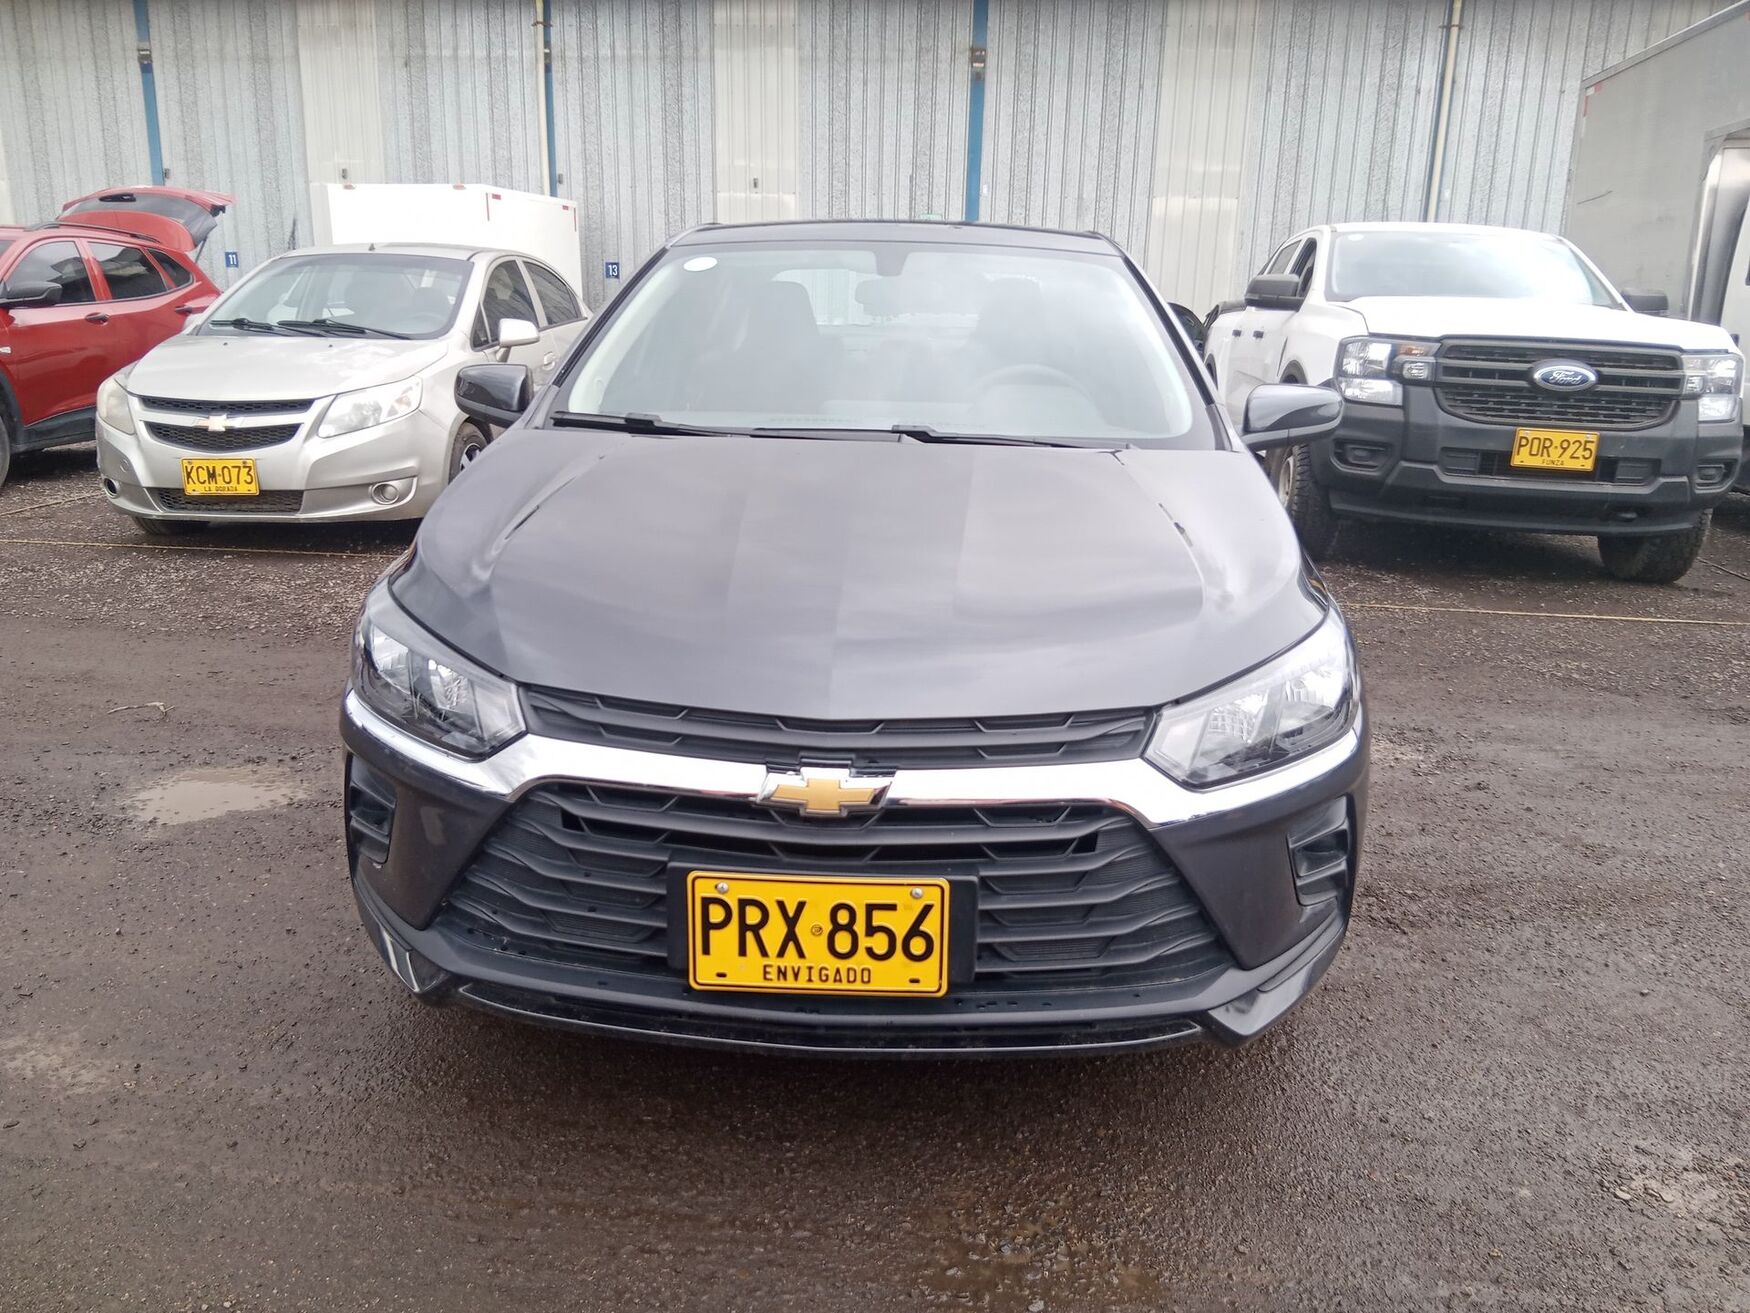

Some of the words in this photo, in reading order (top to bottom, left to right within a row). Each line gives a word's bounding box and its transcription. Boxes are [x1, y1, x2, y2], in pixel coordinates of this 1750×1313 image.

[229, 254, 237, 265] 11
[608, 264, 618, 276] 13
[1549, 370, 1583, 385] Ford
[700, 896, 807, 959] PRX
[826, 902, 935, 963] 856
[762, 964, 872, 985] ENVIGADO
